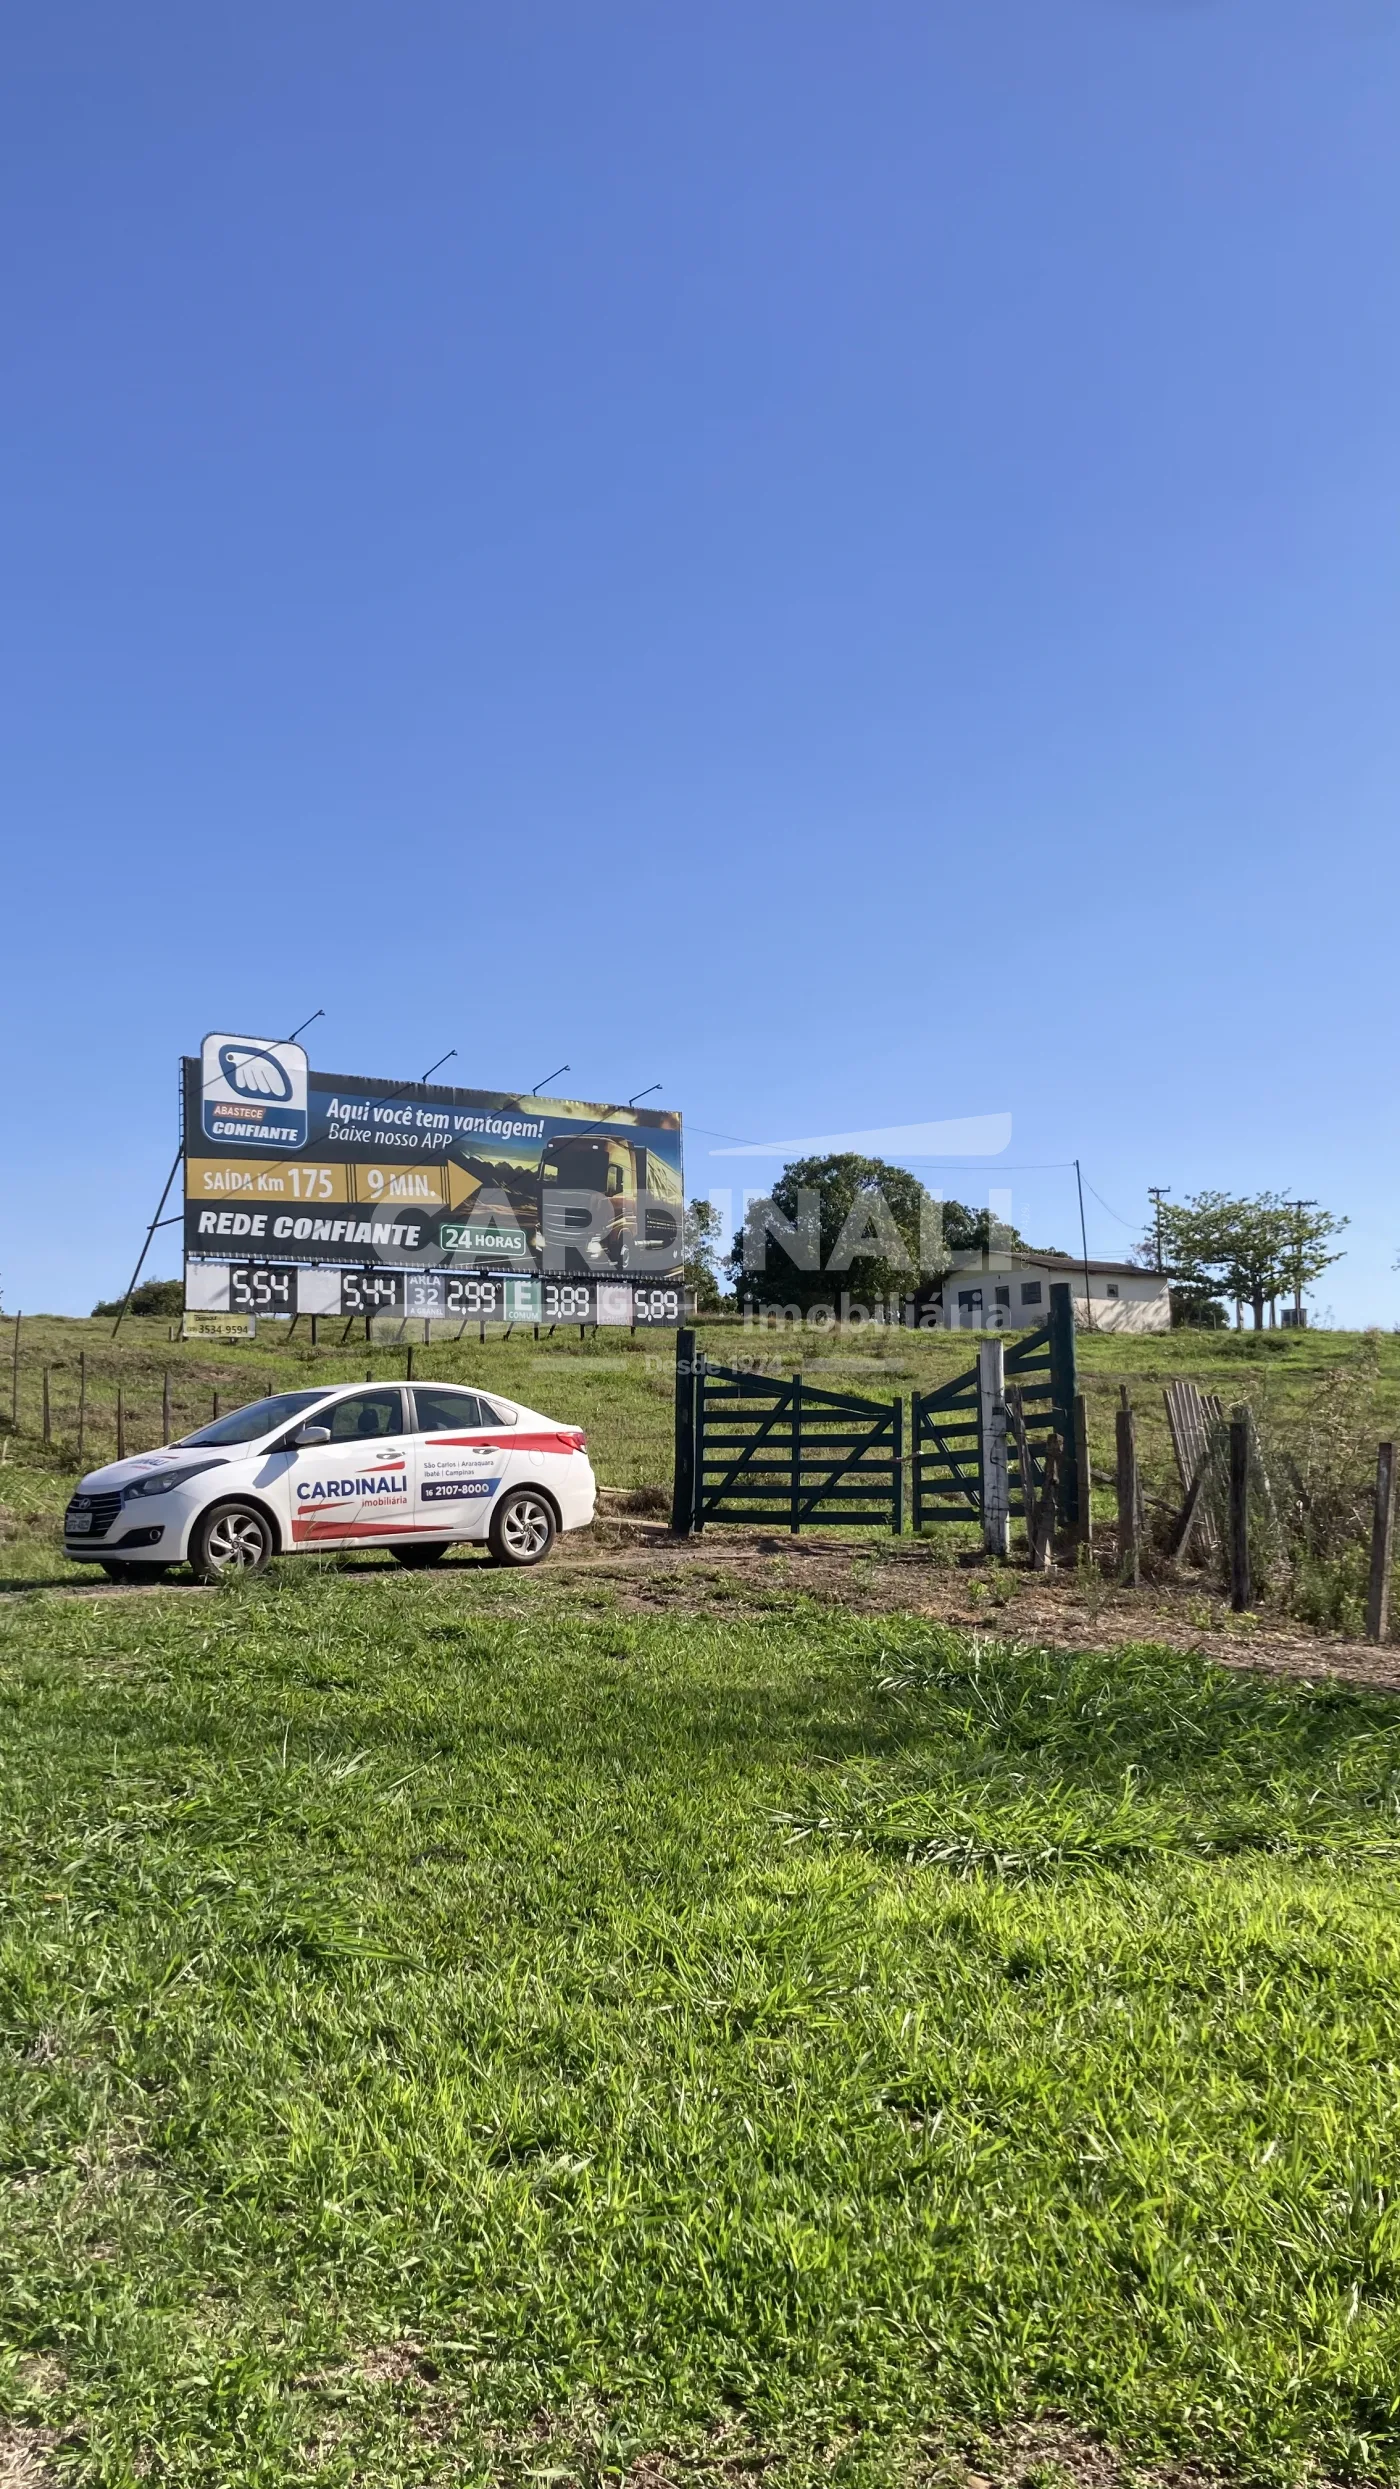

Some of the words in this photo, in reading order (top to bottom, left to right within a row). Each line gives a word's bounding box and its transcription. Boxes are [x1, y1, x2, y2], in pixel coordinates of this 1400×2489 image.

[213, 1105, 264, 1119] ABASTECE
[326, 1098, 370, 1124] Aqui
[374, 1106, 412, 1126] você
[415, 1109, 449, 1129] tem
[454, 1115, 545, 1140] vantagem!
[212, 1121, 298, 1141] CONFIANTE
[328, 1123, 371, 1143] Baixe
[375, 1130, 418, 1147] nosso
[421, 1132, 453, 1149] APP
[203, 1169, 252, 1191] SAÍDA
[257, 1173, 284, 1191] Km
[288, 1168, 333, 1198] 175
[367, 1169, 384, 1199] 9
[389, 1173, 436, 1197] MIN.
[198, 1211, 268, 1236] REDE
[273, 1216, 421, 1247] CONFIANTE
[445, 1229, 472, 1249] 24
[475, 1234, 522, 1249] HORAS
[409, 1276, 441, 1286] ARLA
[414, 1288, 439, 1306] 32
[514, 1281, 533, 1311] E
[602, 1287, 624, 1316] G
[508, 1311, 538, 1320] COMUM
[199, 1325, 248, 1334] 3534-9594
[296, 1475, 407, 1500] CARDINALI
[436, 1483, 489, 1496] 2107-8000
[361, 1496, 408, 1508] imobiliária
